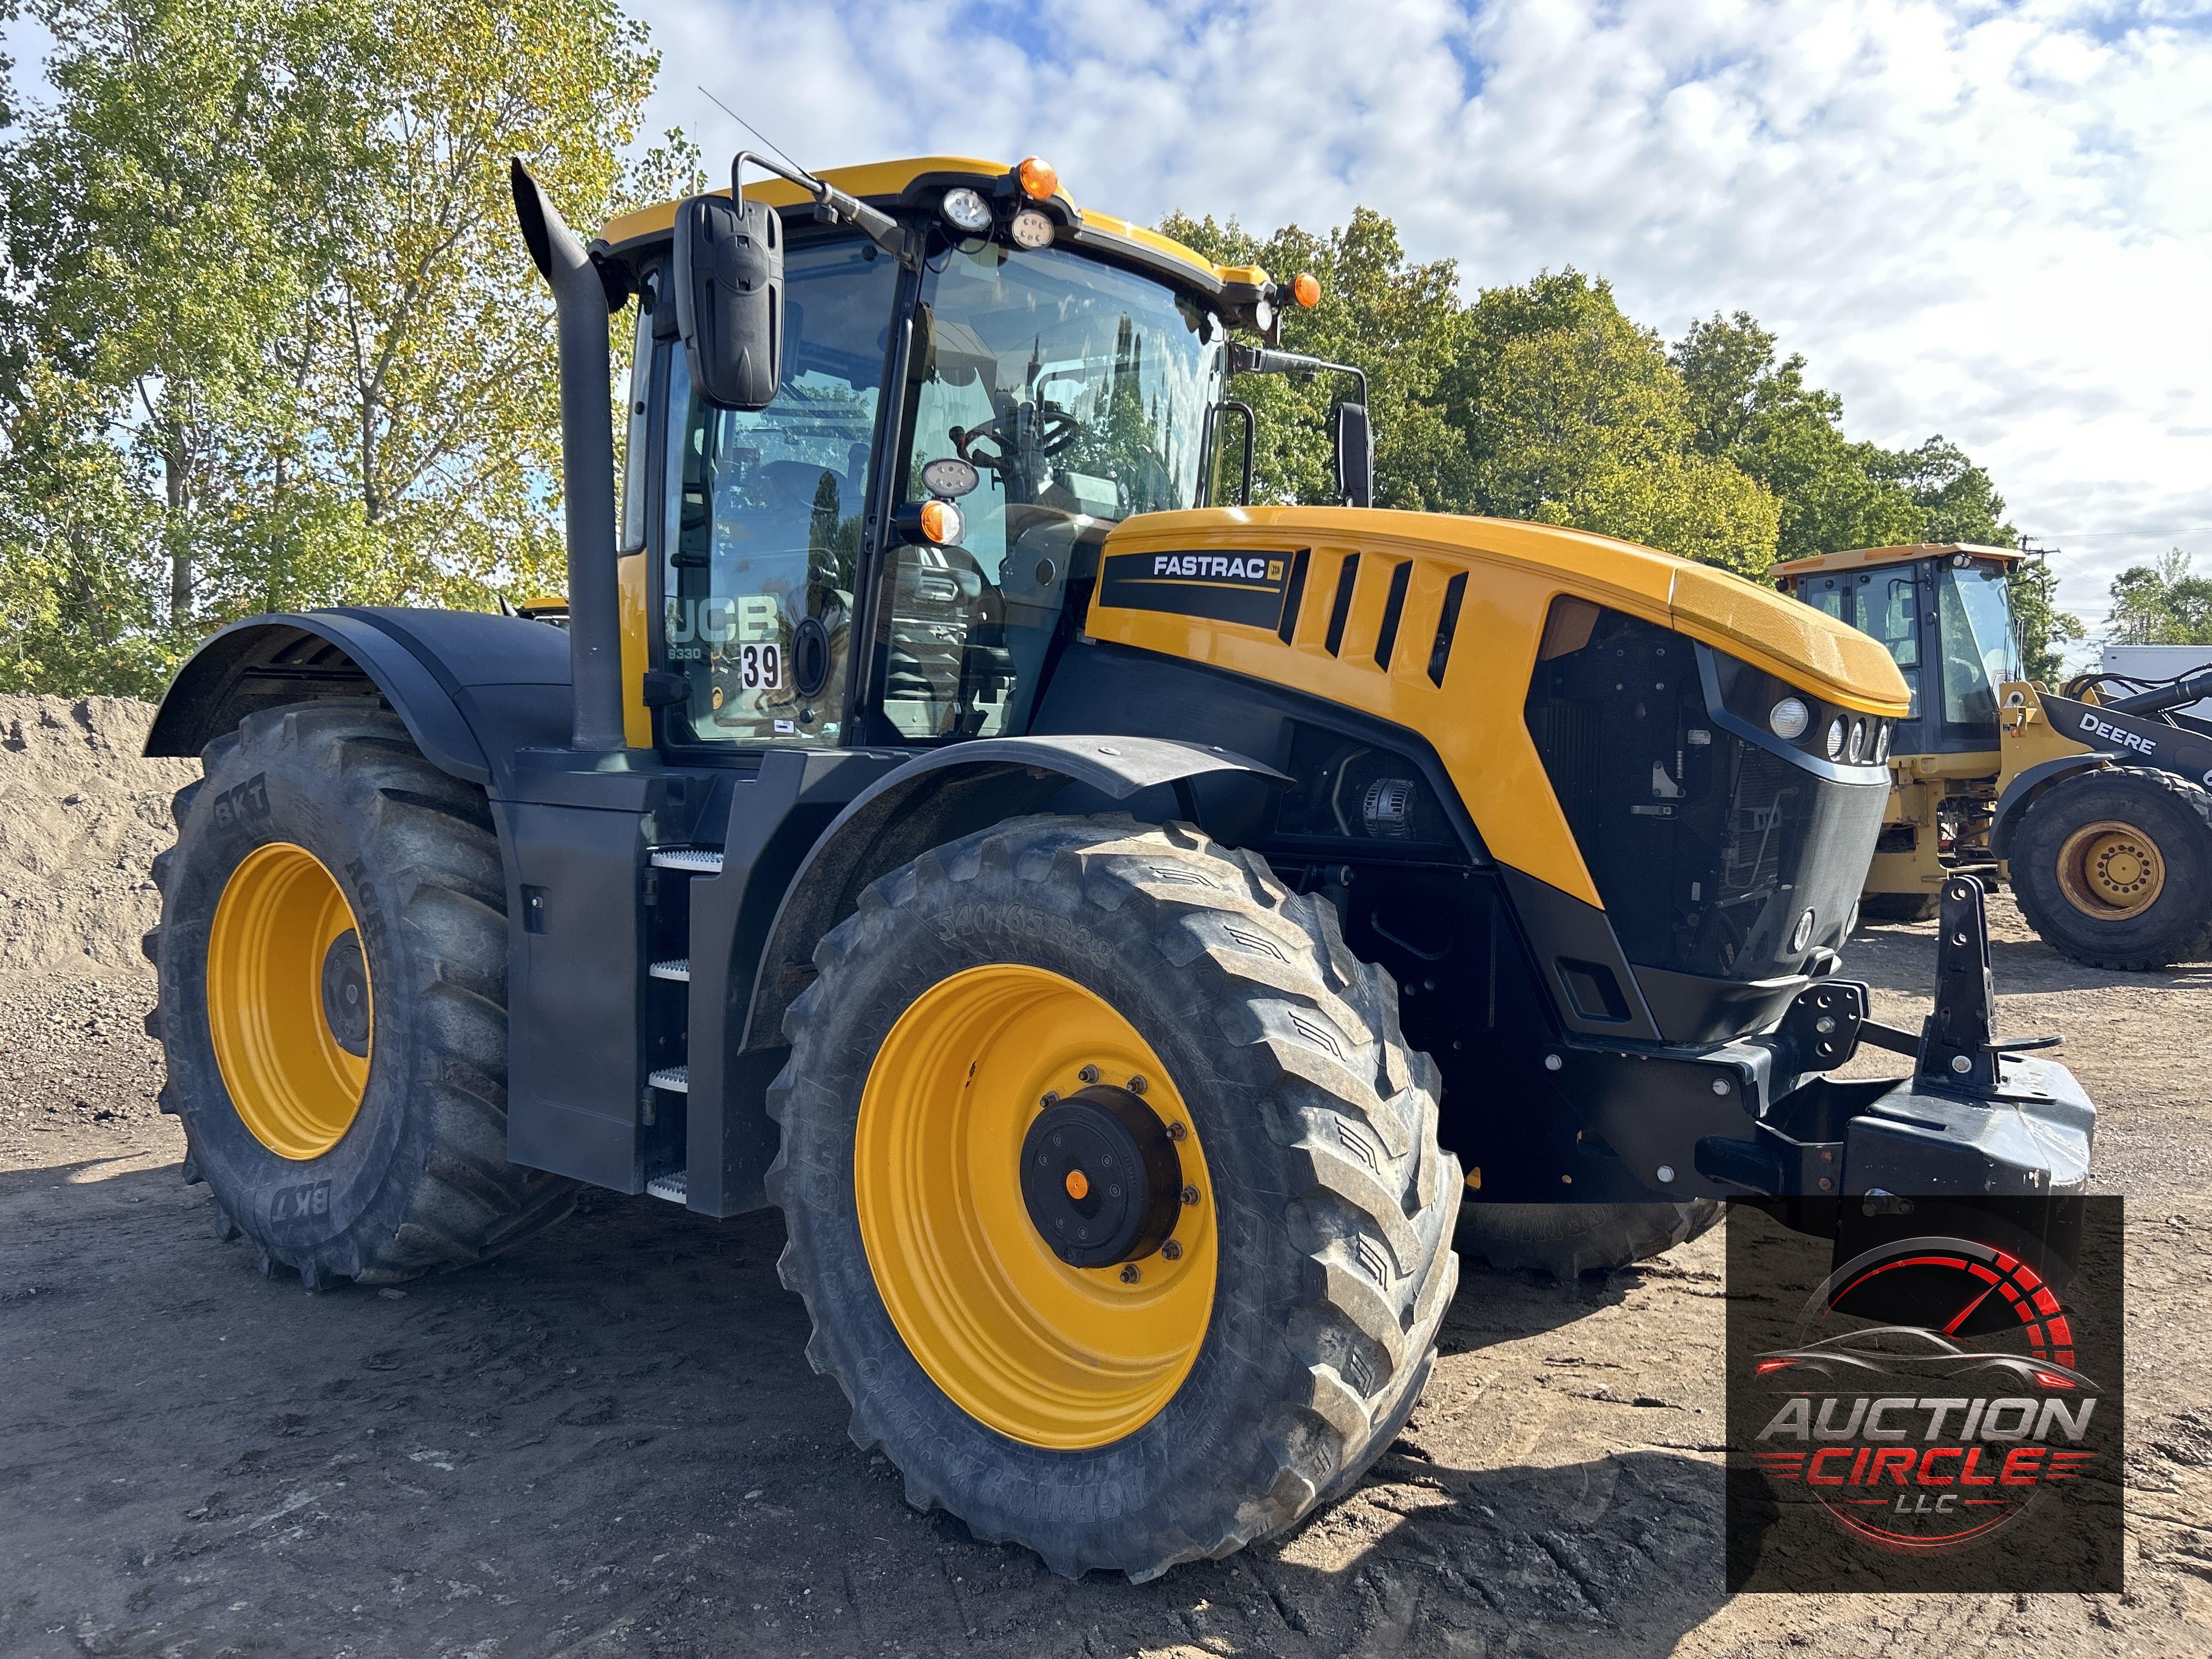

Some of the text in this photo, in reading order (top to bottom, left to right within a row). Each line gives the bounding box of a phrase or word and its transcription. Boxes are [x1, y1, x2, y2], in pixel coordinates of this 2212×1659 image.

[1154, 556, 1266, 580] FASTRAC
[674, 596, 779, 643] JCB
[668, 647, 701, 660] 8330
[743, 645, 778, 687] 39
[2079, 713, 2157, 755] DEERE
[215, 782, 264, 830] BKT
[936, 902, 1114, 969] 540/65R38
[344, 855, 400, 1094] AGRIMAX
[272, 1187, 329, 1222] BKT
[949, 1454, 1148, 1524] AGRIMAX
